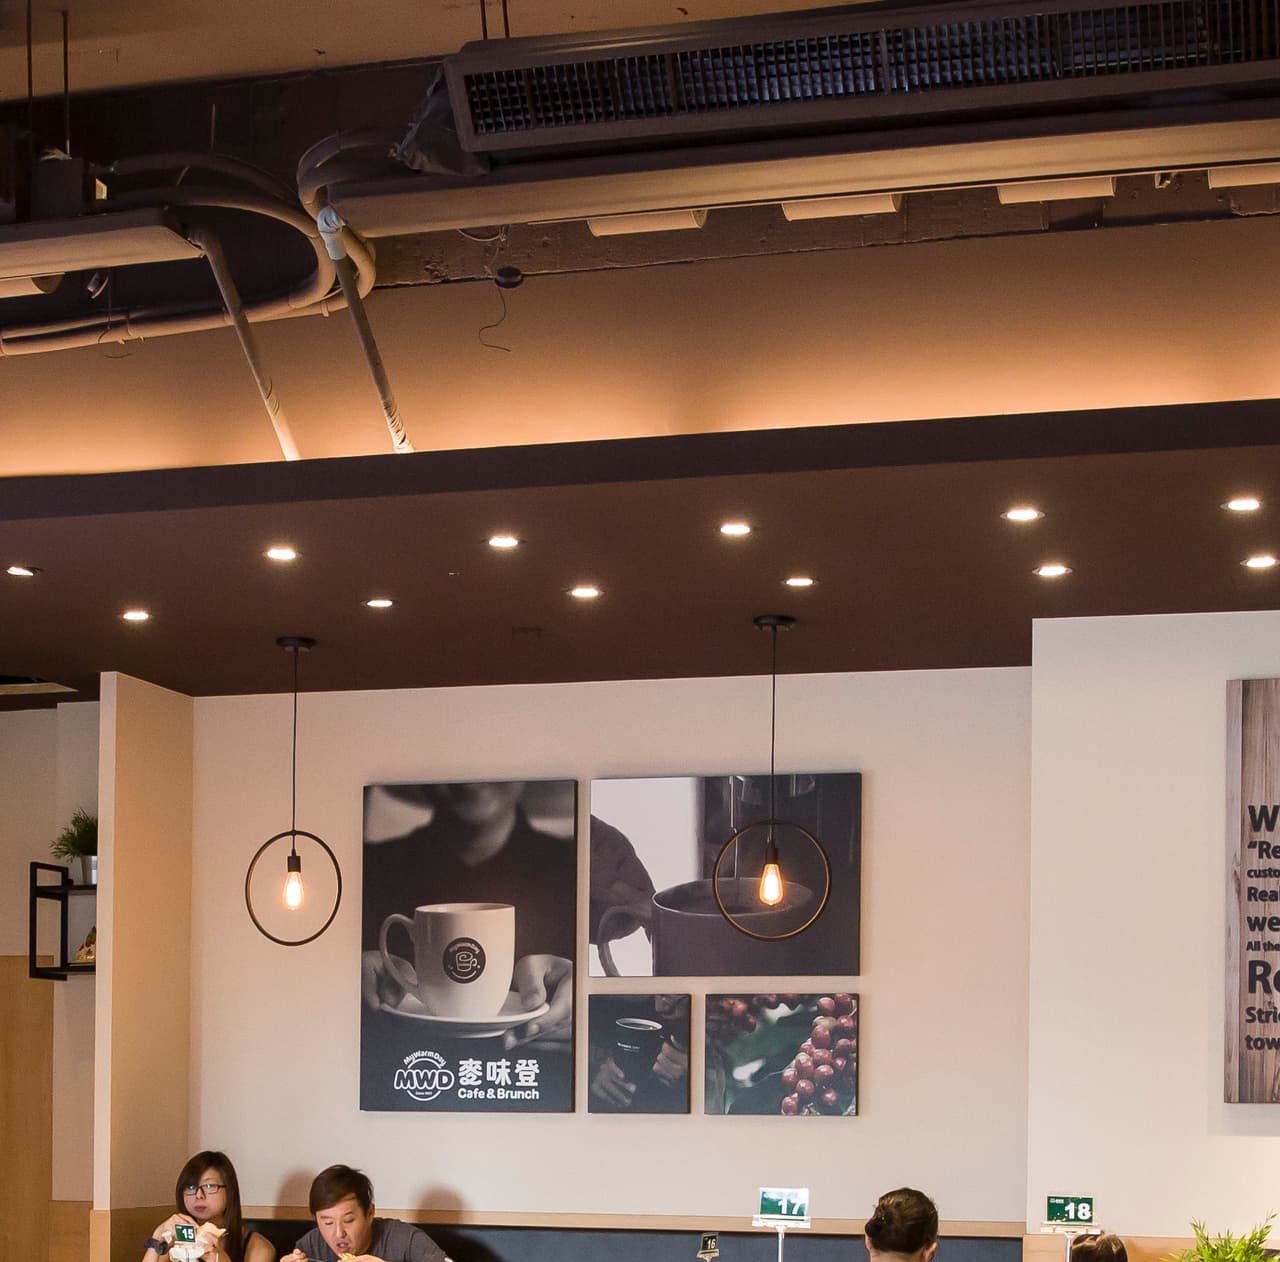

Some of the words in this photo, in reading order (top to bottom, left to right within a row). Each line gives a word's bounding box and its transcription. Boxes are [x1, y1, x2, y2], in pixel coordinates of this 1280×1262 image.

[1247, 917, 1280, 931] we
[393, 1069, 455, 1090] MWD
[458, 1058, 540, 1086] 麥味登
[778, 1199, 806, 1215] 17
[1065, 1202, 1091, 1220] 18
[182, 1228, 194, 1240] 15
[708, 1238, 716, 1249] 16
